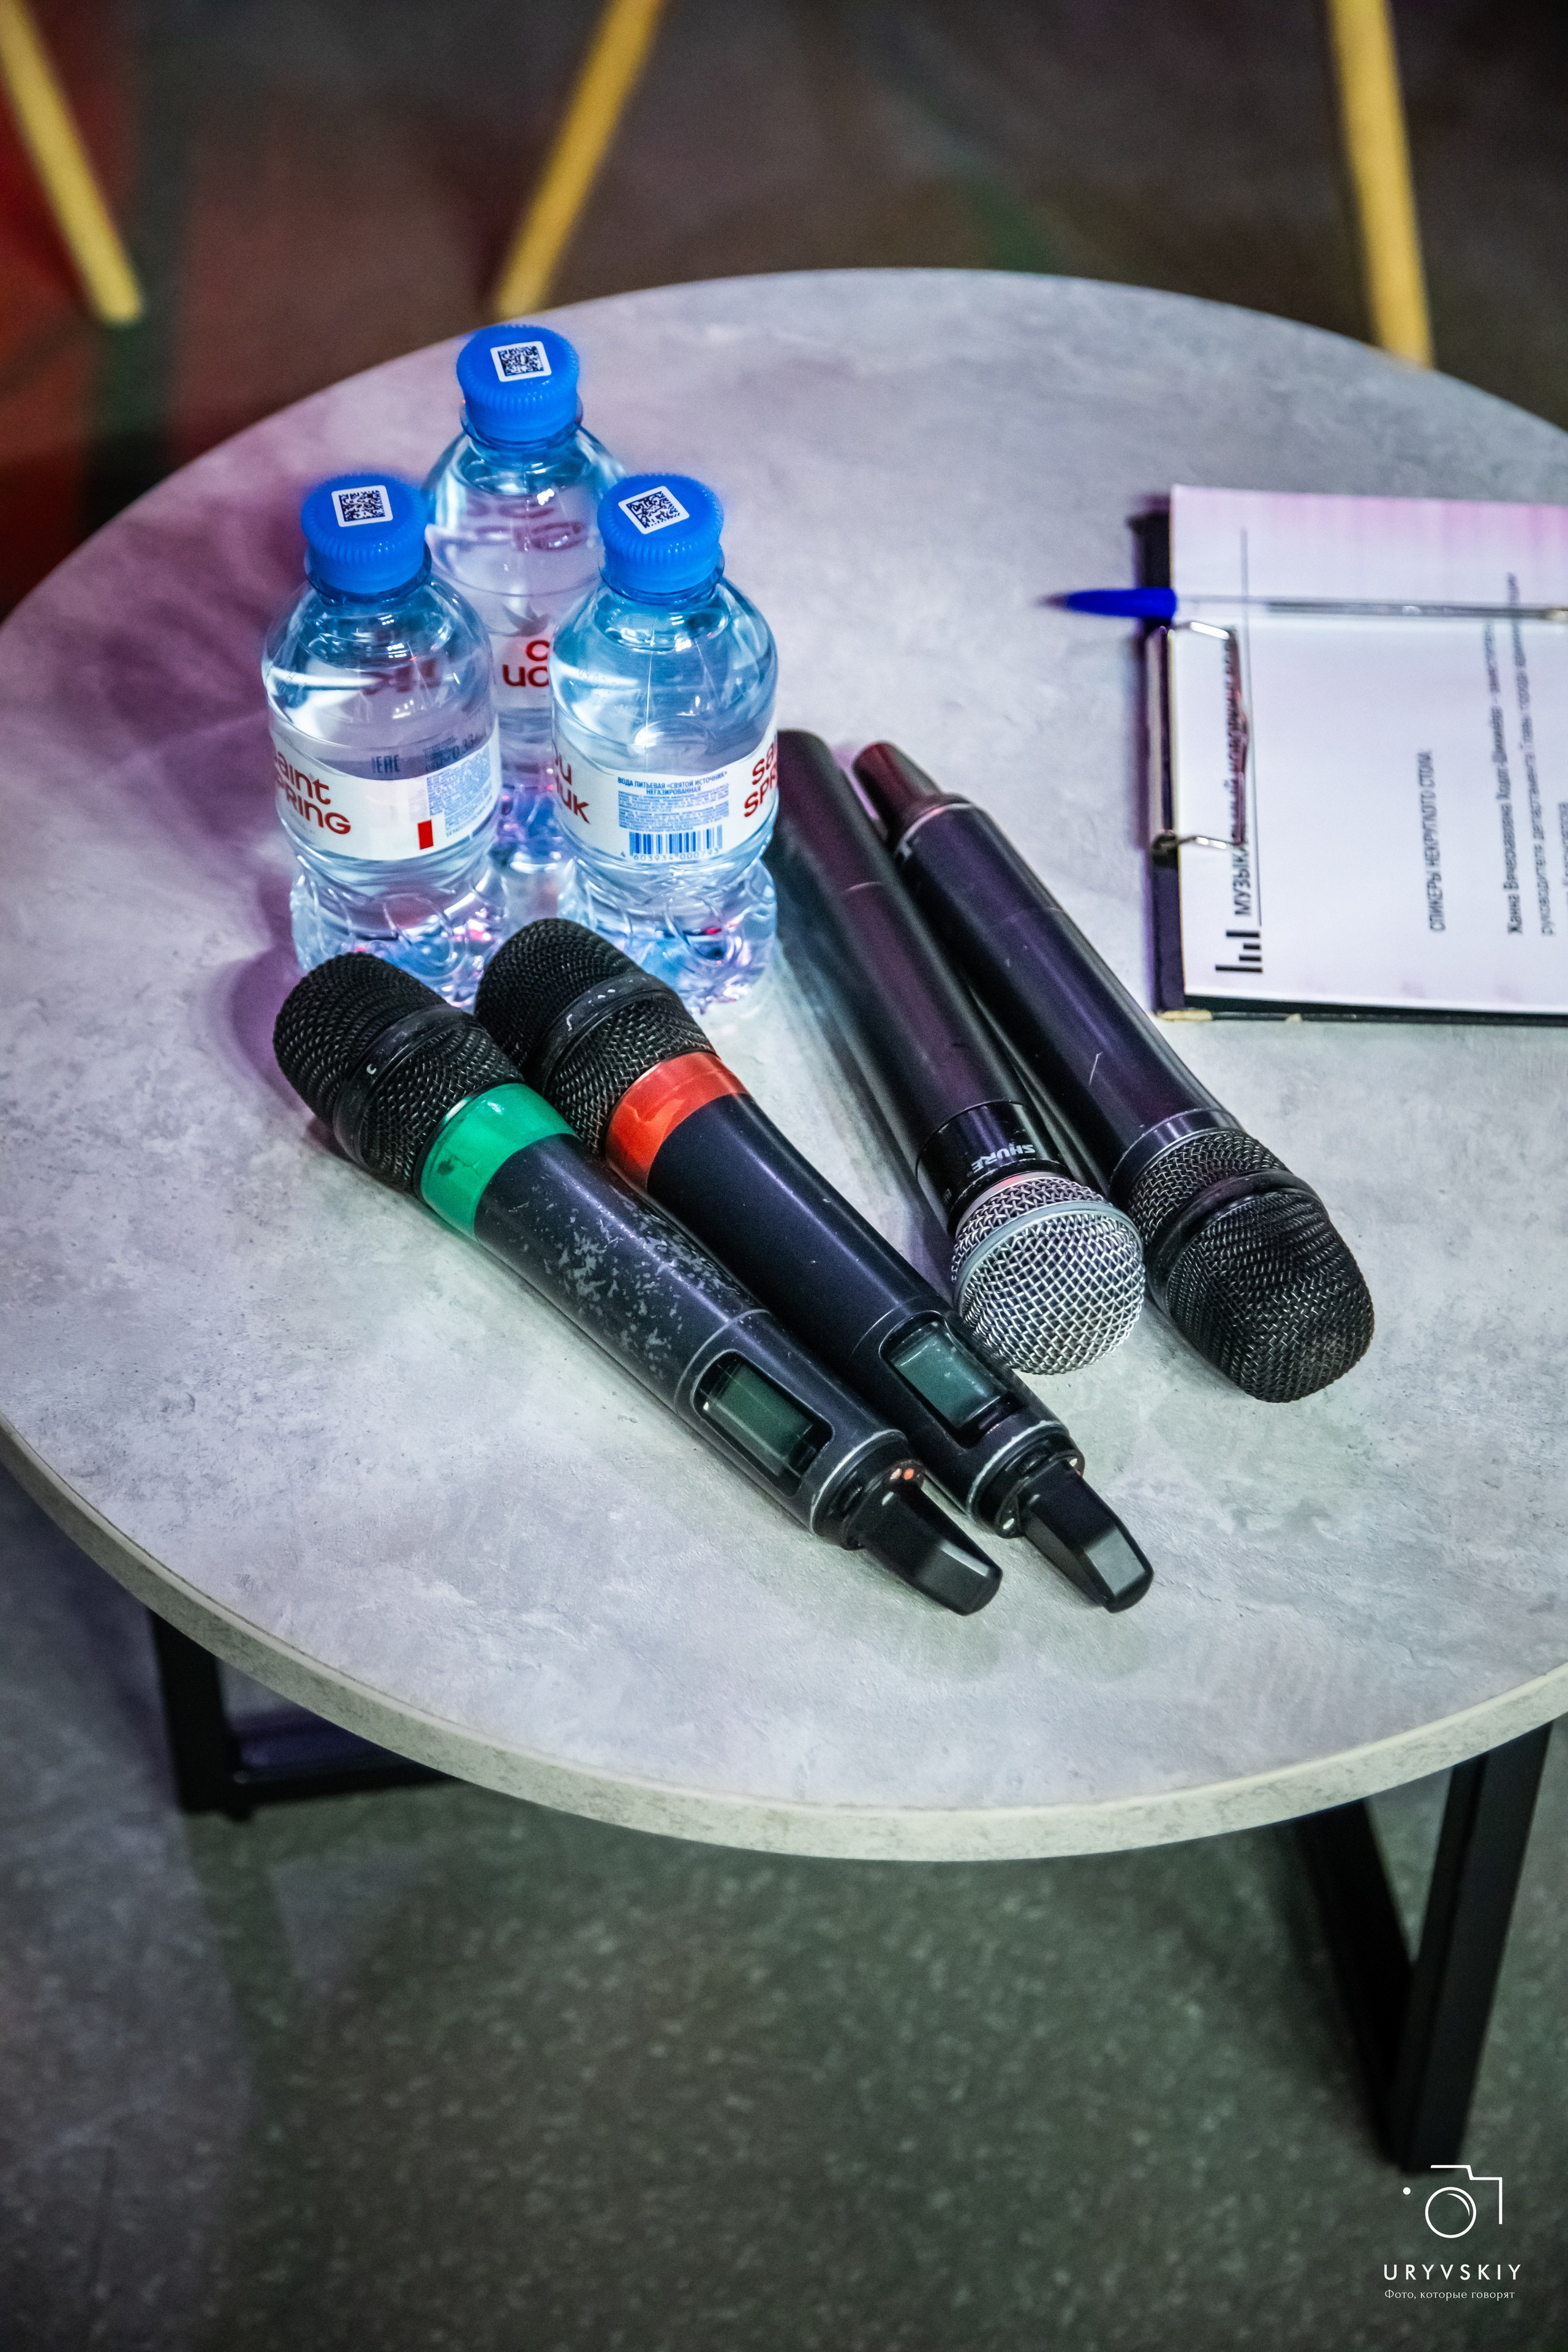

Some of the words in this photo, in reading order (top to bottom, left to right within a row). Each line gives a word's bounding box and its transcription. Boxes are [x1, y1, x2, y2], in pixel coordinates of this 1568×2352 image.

[276, 751, 331, 805] aint
[617, 777, 633, 786] ВОДА
[646, 786, 701, 795] НЕГАЗИРОВАННАЯ
[971, 1144, 1036, 1174] SHURE
